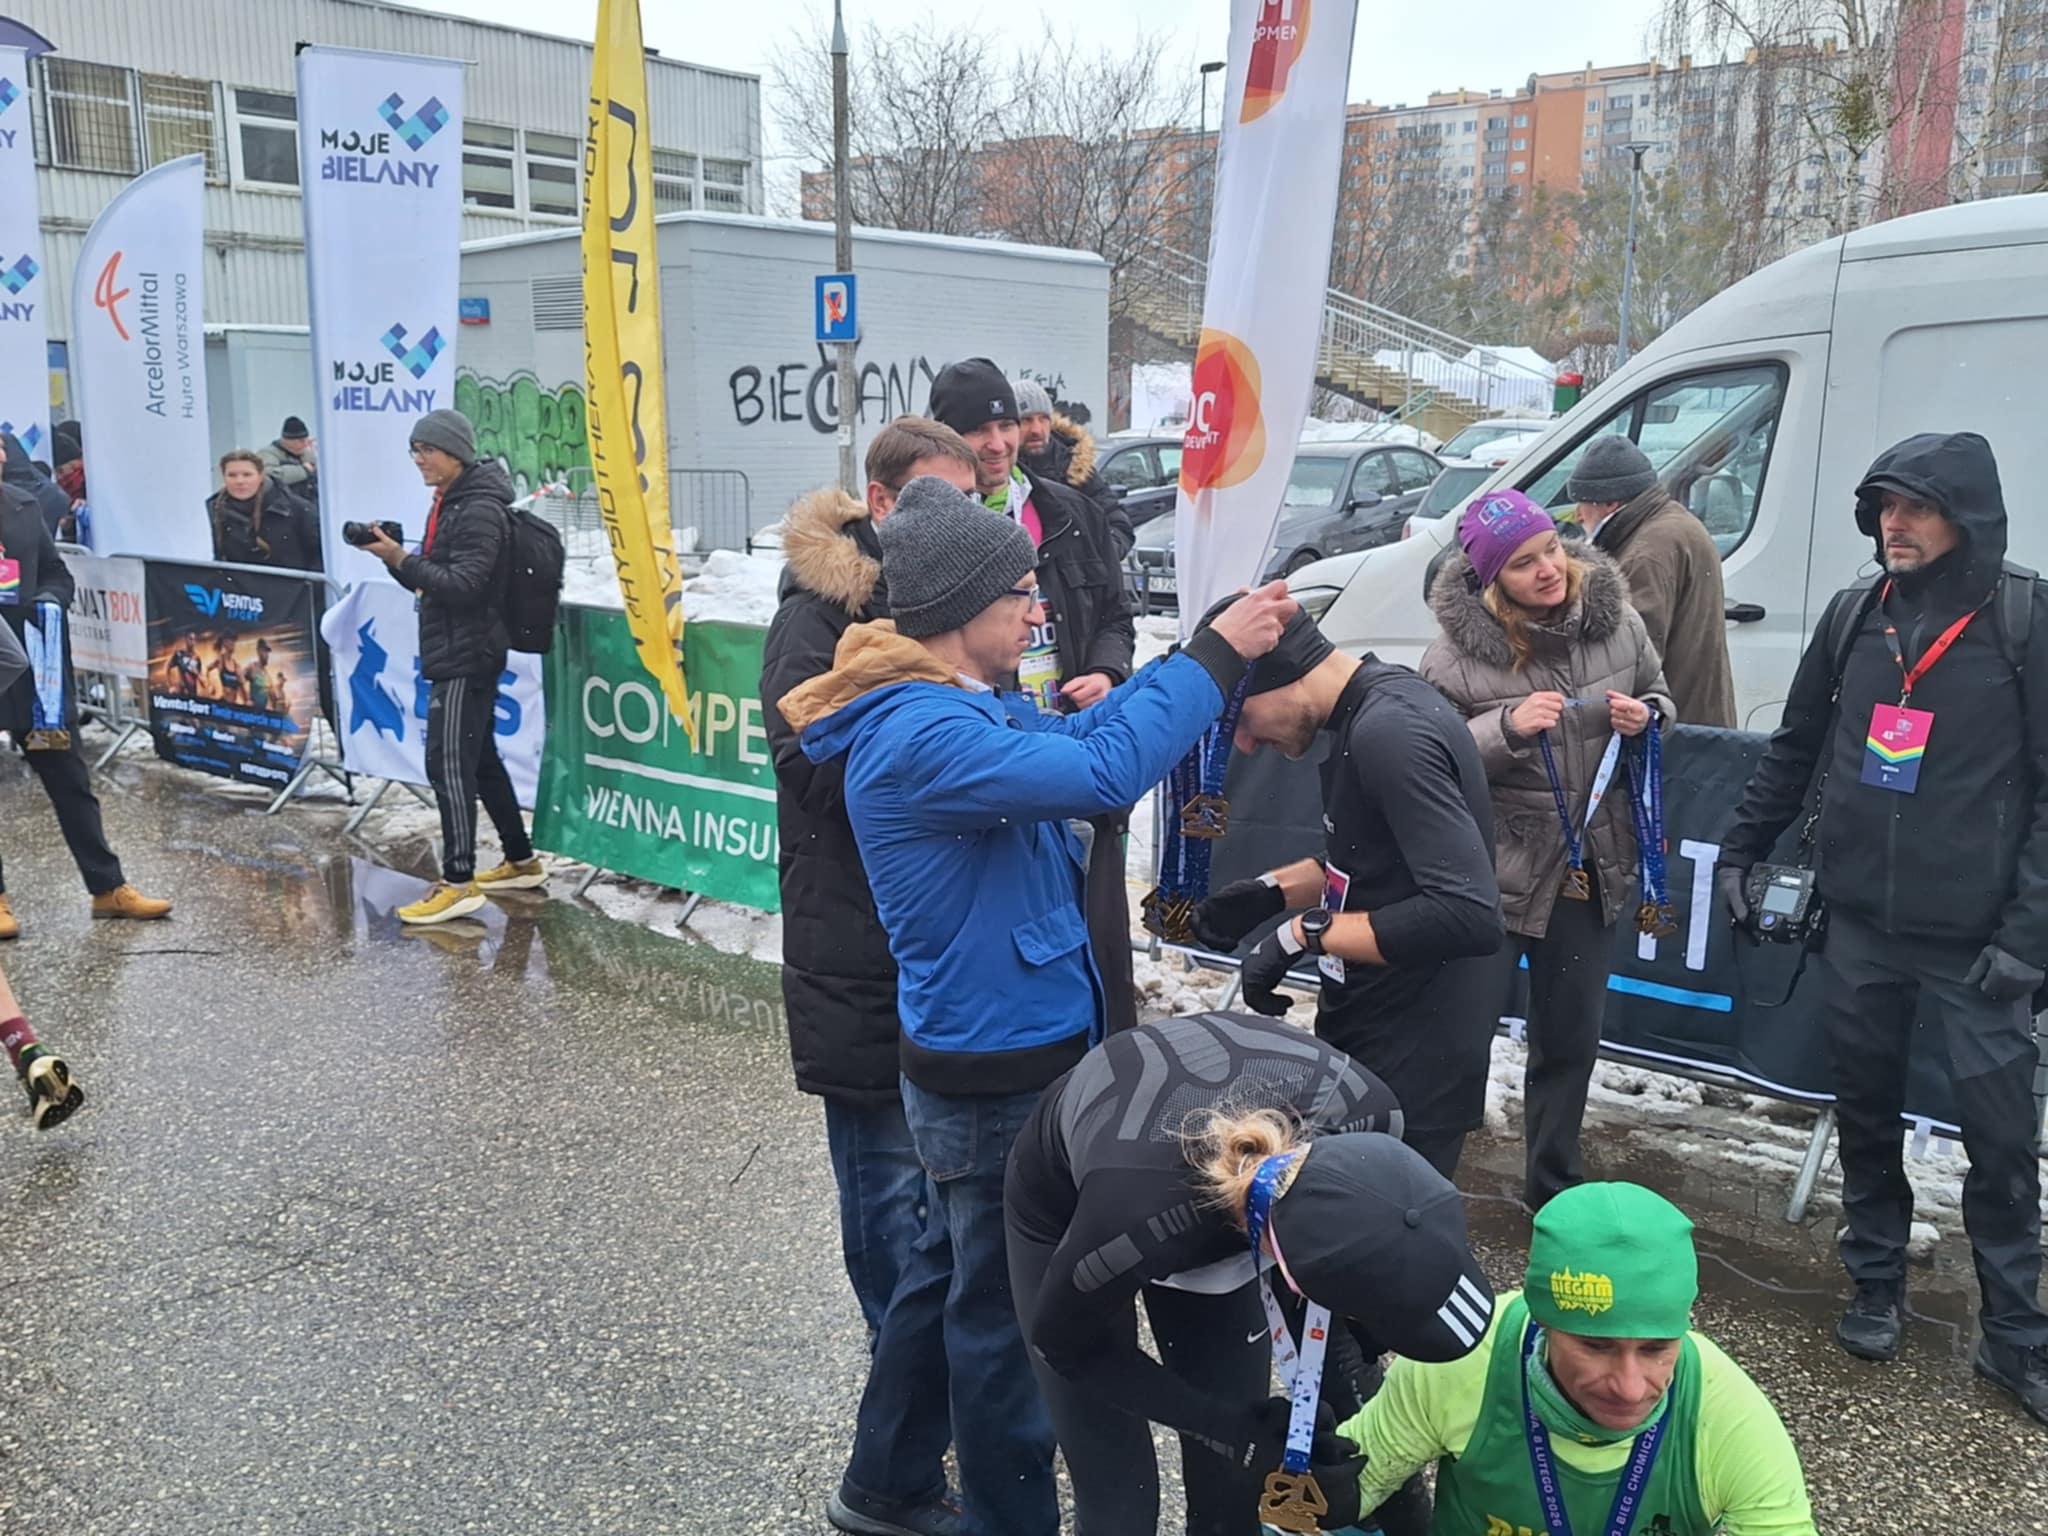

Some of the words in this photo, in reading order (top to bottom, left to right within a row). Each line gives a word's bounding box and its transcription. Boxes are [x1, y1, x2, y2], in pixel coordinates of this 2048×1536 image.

[321, 129, 390, 155] MOJE
[321, 156, 440, 188] BIELANY
[174, 273, 190, 370] Warszawa
[823, 282, 847, 334] P
[138, 272, 167, 417] ArcelorMittal
[182, 376, 194, 418] Huta
[587, 784, 687, 843] VIENNA
[694, 810, 781, 864] INSU
[1535, 1447, 1553, 1494] LUTEGO
